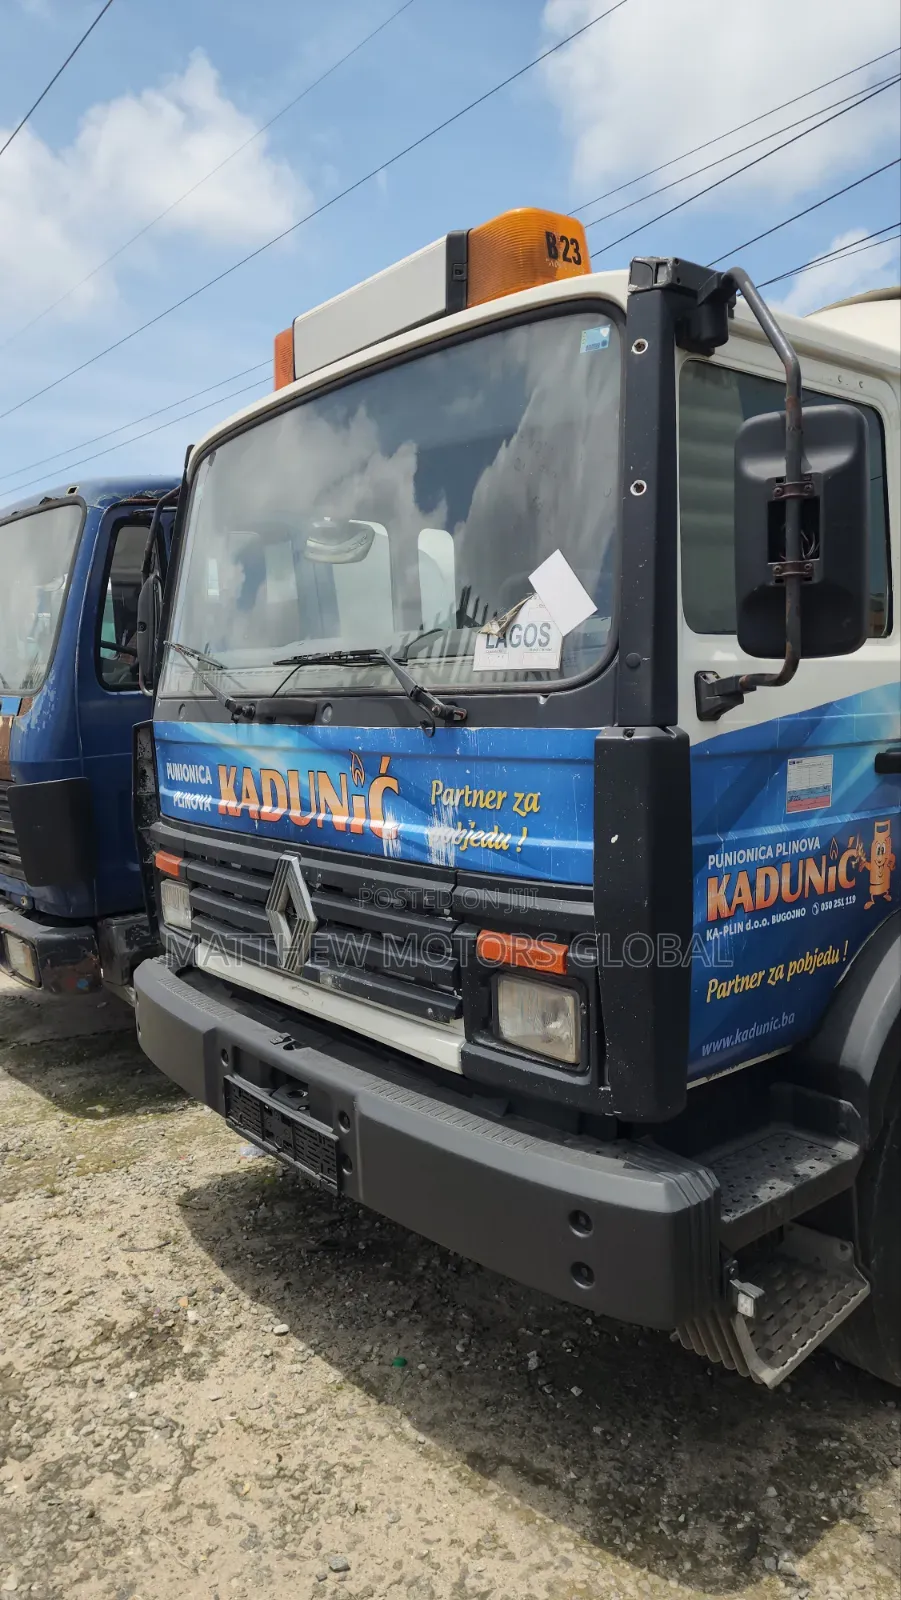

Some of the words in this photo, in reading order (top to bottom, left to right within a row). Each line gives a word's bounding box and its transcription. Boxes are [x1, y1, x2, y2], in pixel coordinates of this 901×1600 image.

[486, 622, 551, 649] LAGOS
[166, 762, 212, 785] PUNIONICA
[173, 790, 211, 812] PLINOVA
[430, 779, 507, 810] Partner
[512, 791, 541, 817] za
[708, 845, 774, 870] PUNIONICA
[775, 836, 821, 855] PLINOVA
[706, 921, 744, 942] KA-PLIN
[746, 918, 770, 931] d.o.o.
[771, 907, 807, 925] BUGOJNO
[706, 970, 767, 1003] Partner
[767, 963, 785, 987] za
[786, 945, 840, 982] pobjedu
[701, 1011, 796, 1057] www.kadunic.ba
